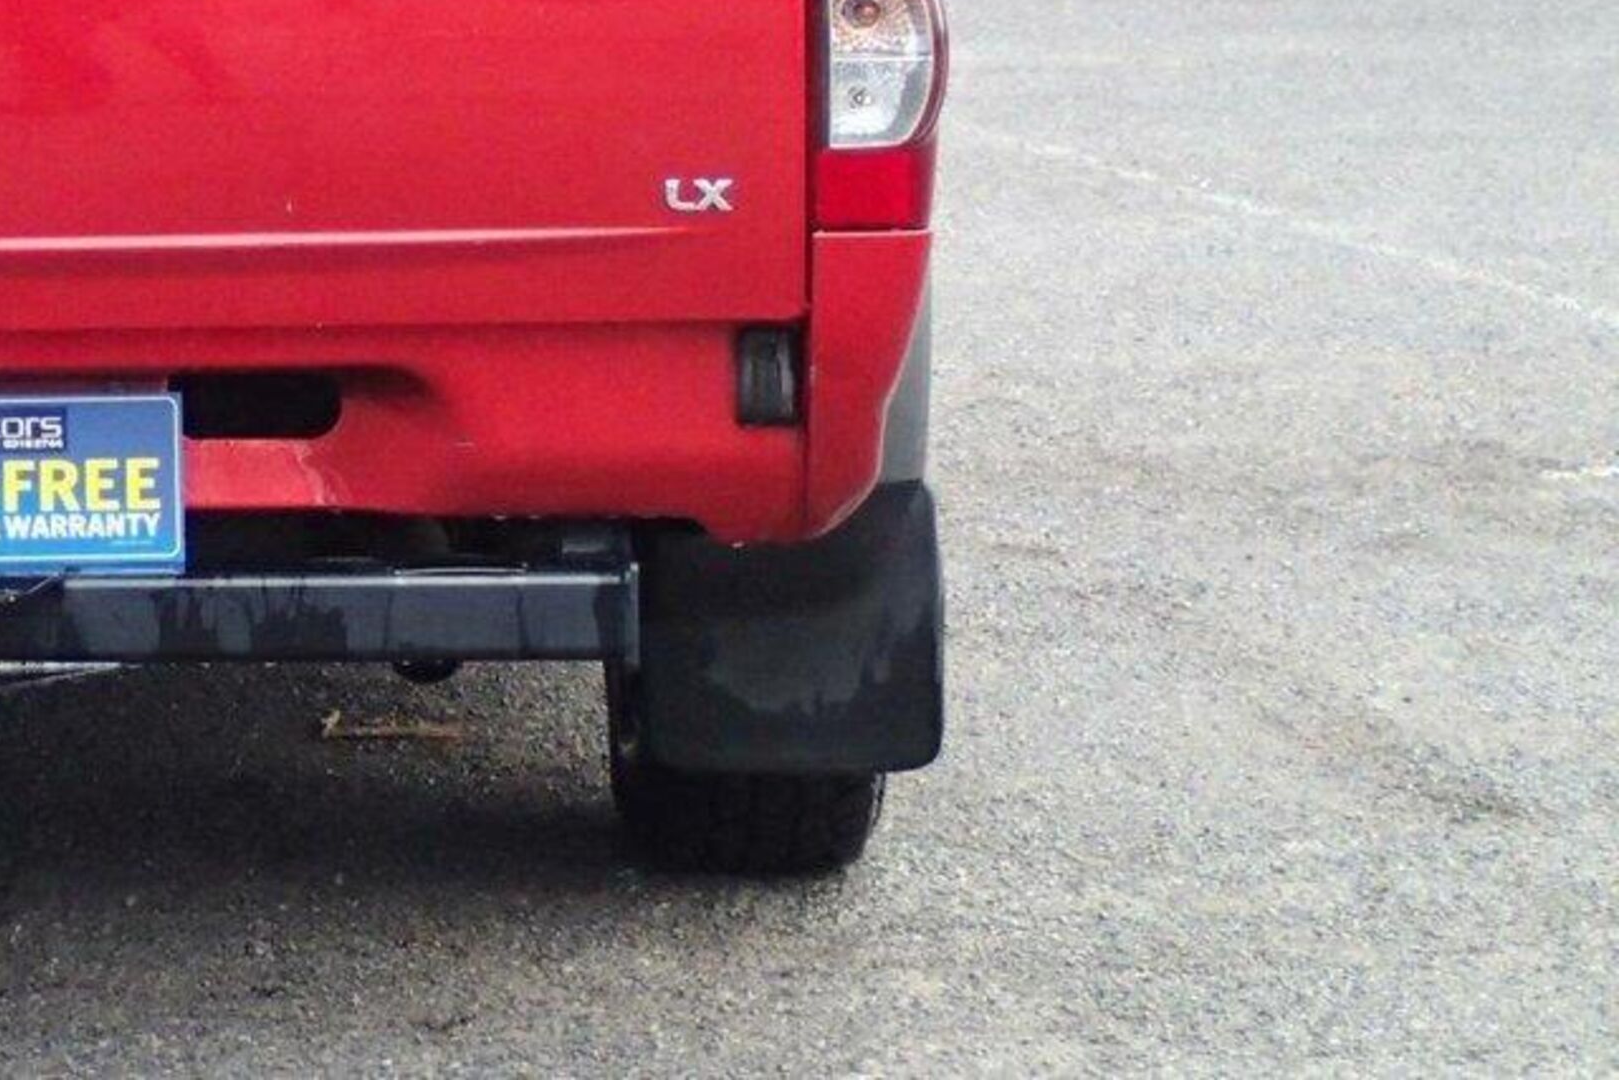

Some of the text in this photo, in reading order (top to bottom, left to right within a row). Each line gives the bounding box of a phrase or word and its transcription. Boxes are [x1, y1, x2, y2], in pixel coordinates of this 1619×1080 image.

[664, 178, 734, 212] LX
[2, 457, 162, 512] FREE
[3, 511, 162, 540] WARRANTY
